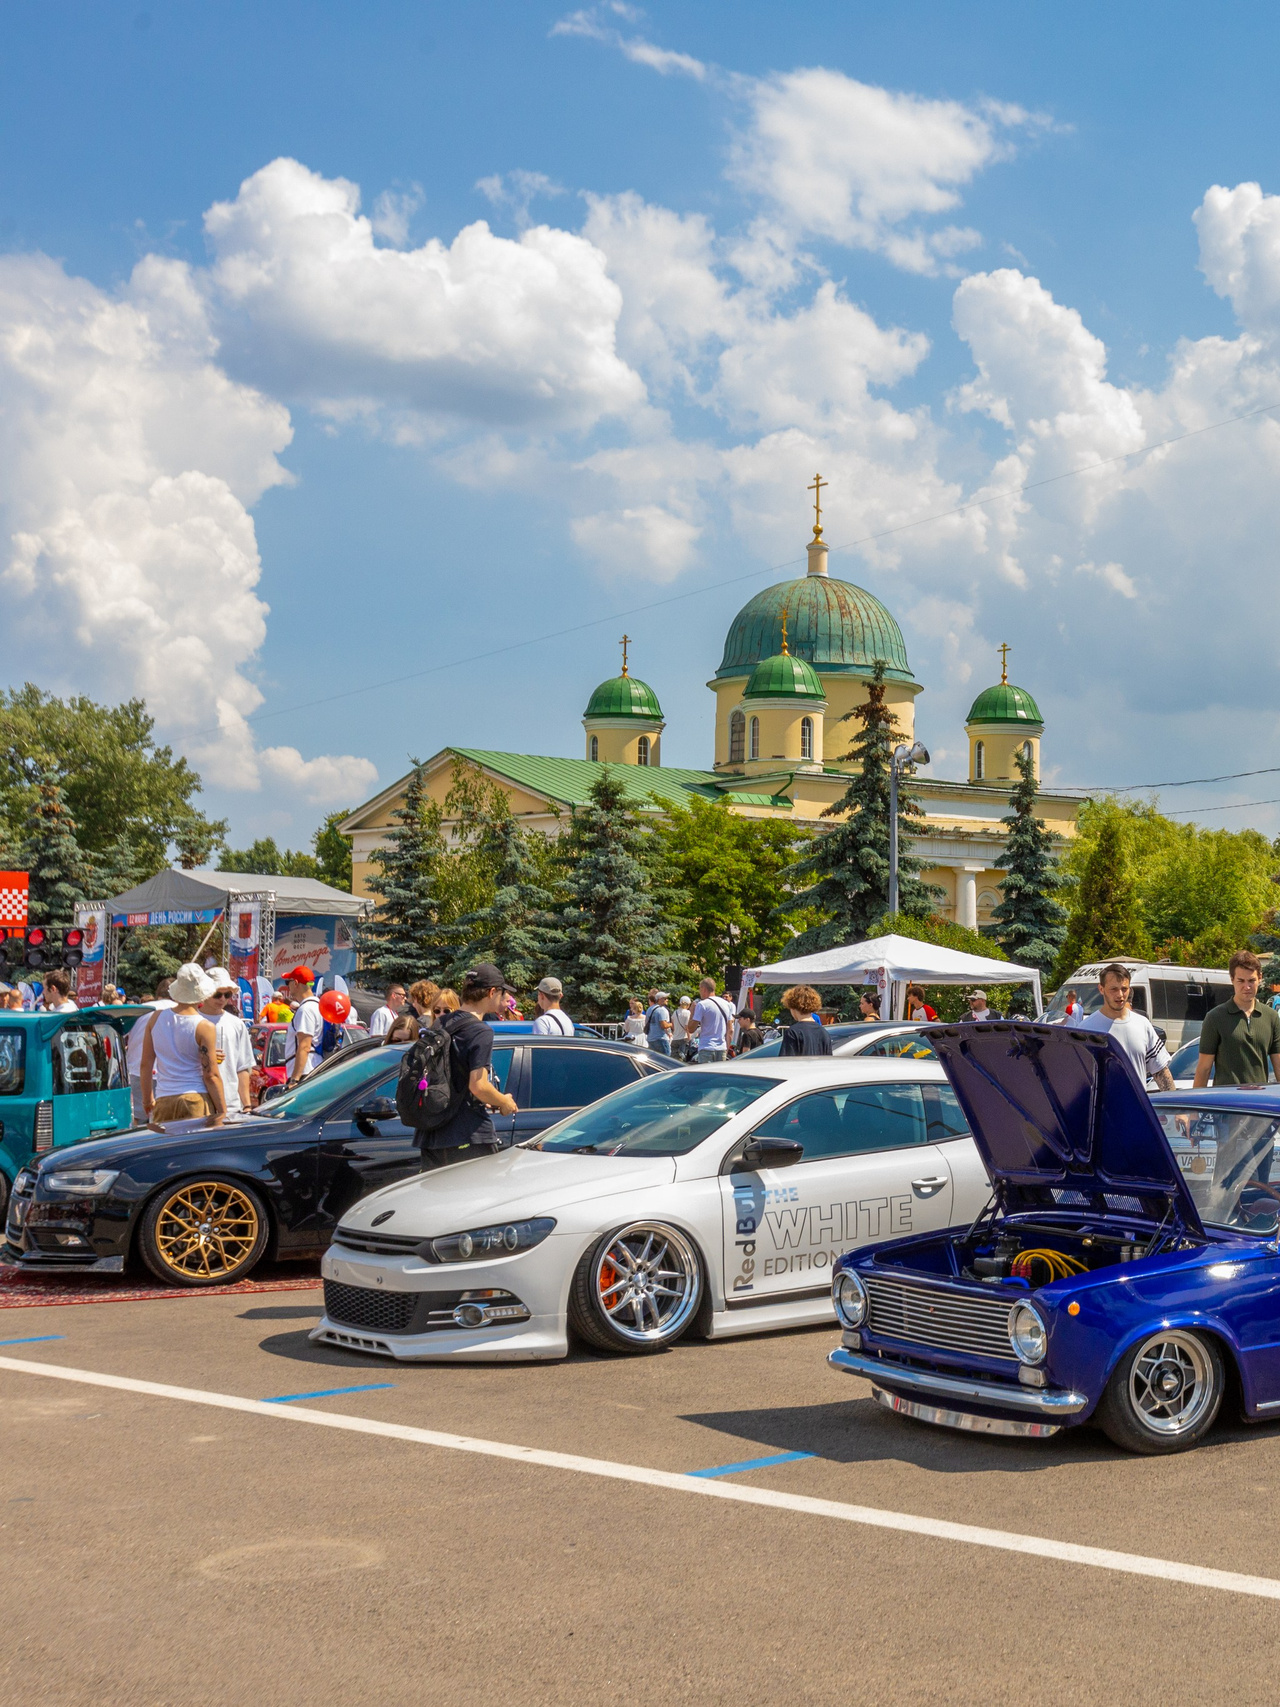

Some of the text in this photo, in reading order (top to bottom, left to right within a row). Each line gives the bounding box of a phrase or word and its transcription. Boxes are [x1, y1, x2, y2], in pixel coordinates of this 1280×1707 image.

[129, 913, 135, 925] 12
[150, 911, 166, 925] ДЕНЬ
[168, 910, 192, 923] РОССИИ
[761, 1187, 799, 1205] THE
[733, 1185, 757, 1291] Red Bull
[764, 1194, 912, 1250] WHITE
